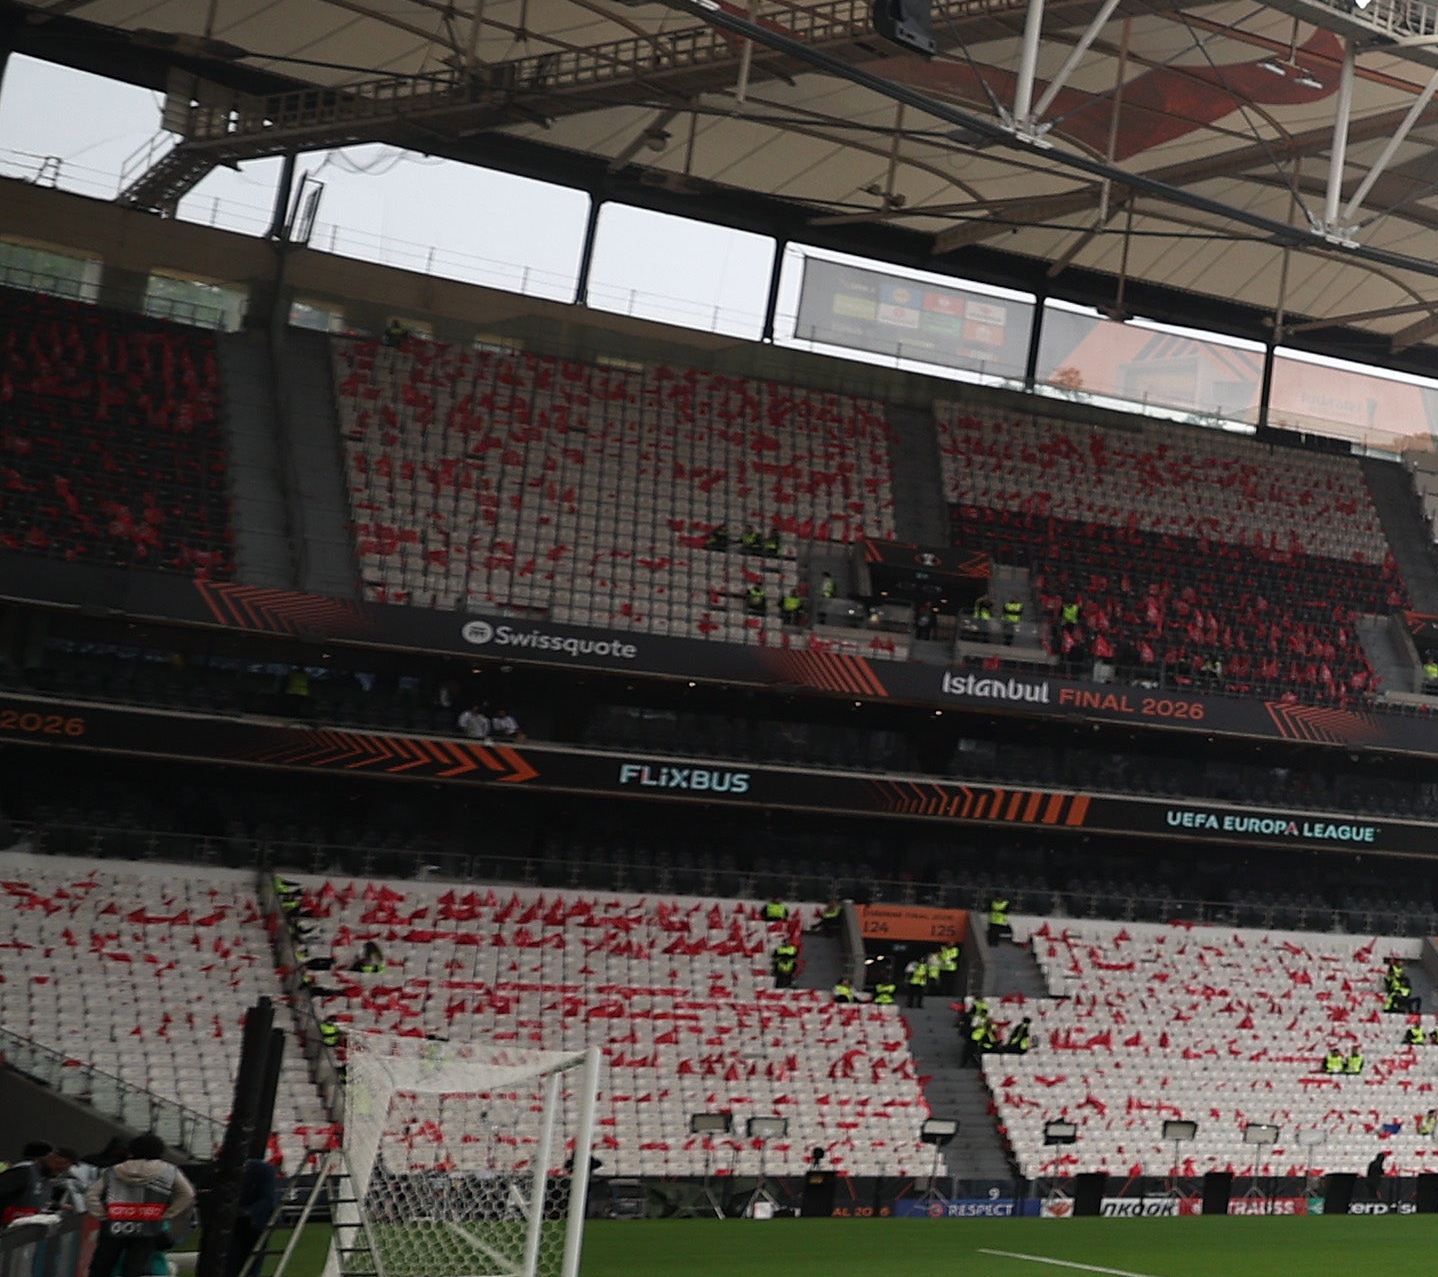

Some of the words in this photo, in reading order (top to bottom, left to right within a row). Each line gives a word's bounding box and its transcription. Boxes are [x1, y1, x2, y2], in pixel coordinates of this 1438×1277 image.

[494, 625, 638, 657] Swissquote
[942, 671, 1050, 704] Istanbul
[1058, 688, 1135, 713] FINAL
[1141, 698, 1205, 720] 2026
[0, 709, 86, 736] 2026
[1166, 810, 1219, 830] UEFA
[1222, 815, 1299, 836] EUROPA
[1302, 822, 1377, 843] LEAGUE
[948, 1203, 1015, 1217] RESPECT
